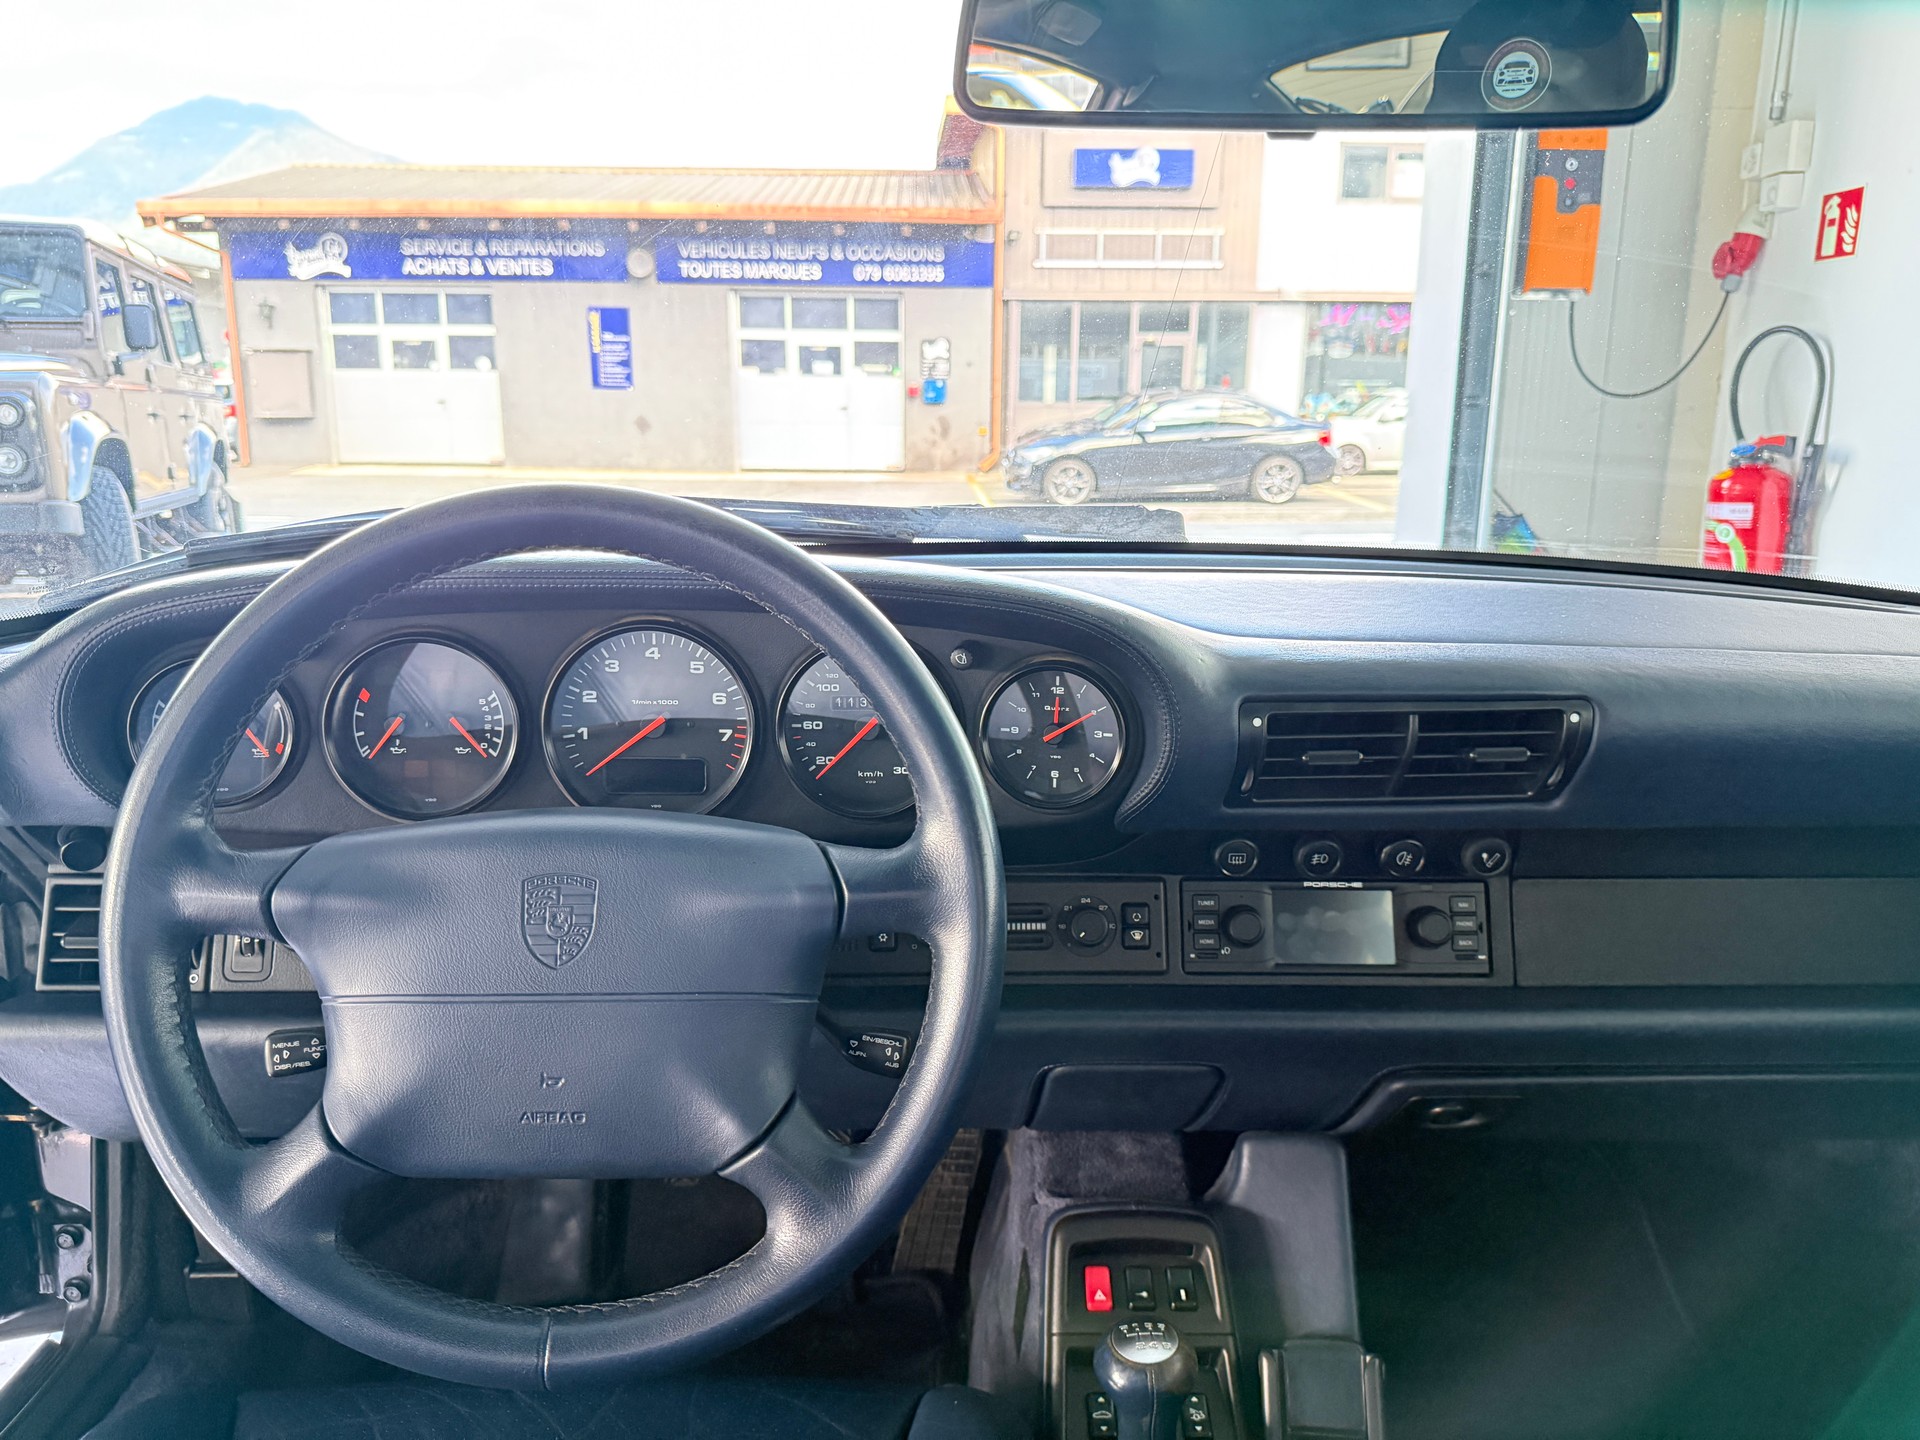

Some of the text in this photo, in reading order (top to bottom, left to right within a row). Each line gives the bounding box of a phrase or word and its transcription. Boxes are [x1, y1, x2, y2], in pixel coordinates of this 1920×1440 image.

[400, 239, 605, 257] SERVICE & REPARATIONS
[678, 241, 945, 263] VEHICULES NEUFS & OCCASIONS
[401, 257, 554, 276] ACHATS & VENTES
[678, 260, 823, 280] TOUTES MARQUES
[645, 647, 661, 660] 4
[604, 659, 620, 673] 3
[689, 661, 705, 674] 5
[816, 683, 840, 692] 100
[1050, 686, 1065, 695] 12
[582, 690, 598, 703] 2
[712, 692, 727, 705] 6
[802, 721, 823, 730] 60
[1010, 726, 1019, 734] 9
[576, 727, 588, 740] 1
[718, 729, 733, 742] 7
[1093, 730, 1103, 738] 3
[815, 756, 836, 765] 20
[857, 770, 884, 778] km/h
[1050, 770, 1060, 778] 6
[520, 1111, 587, 1125] AIRBAG
